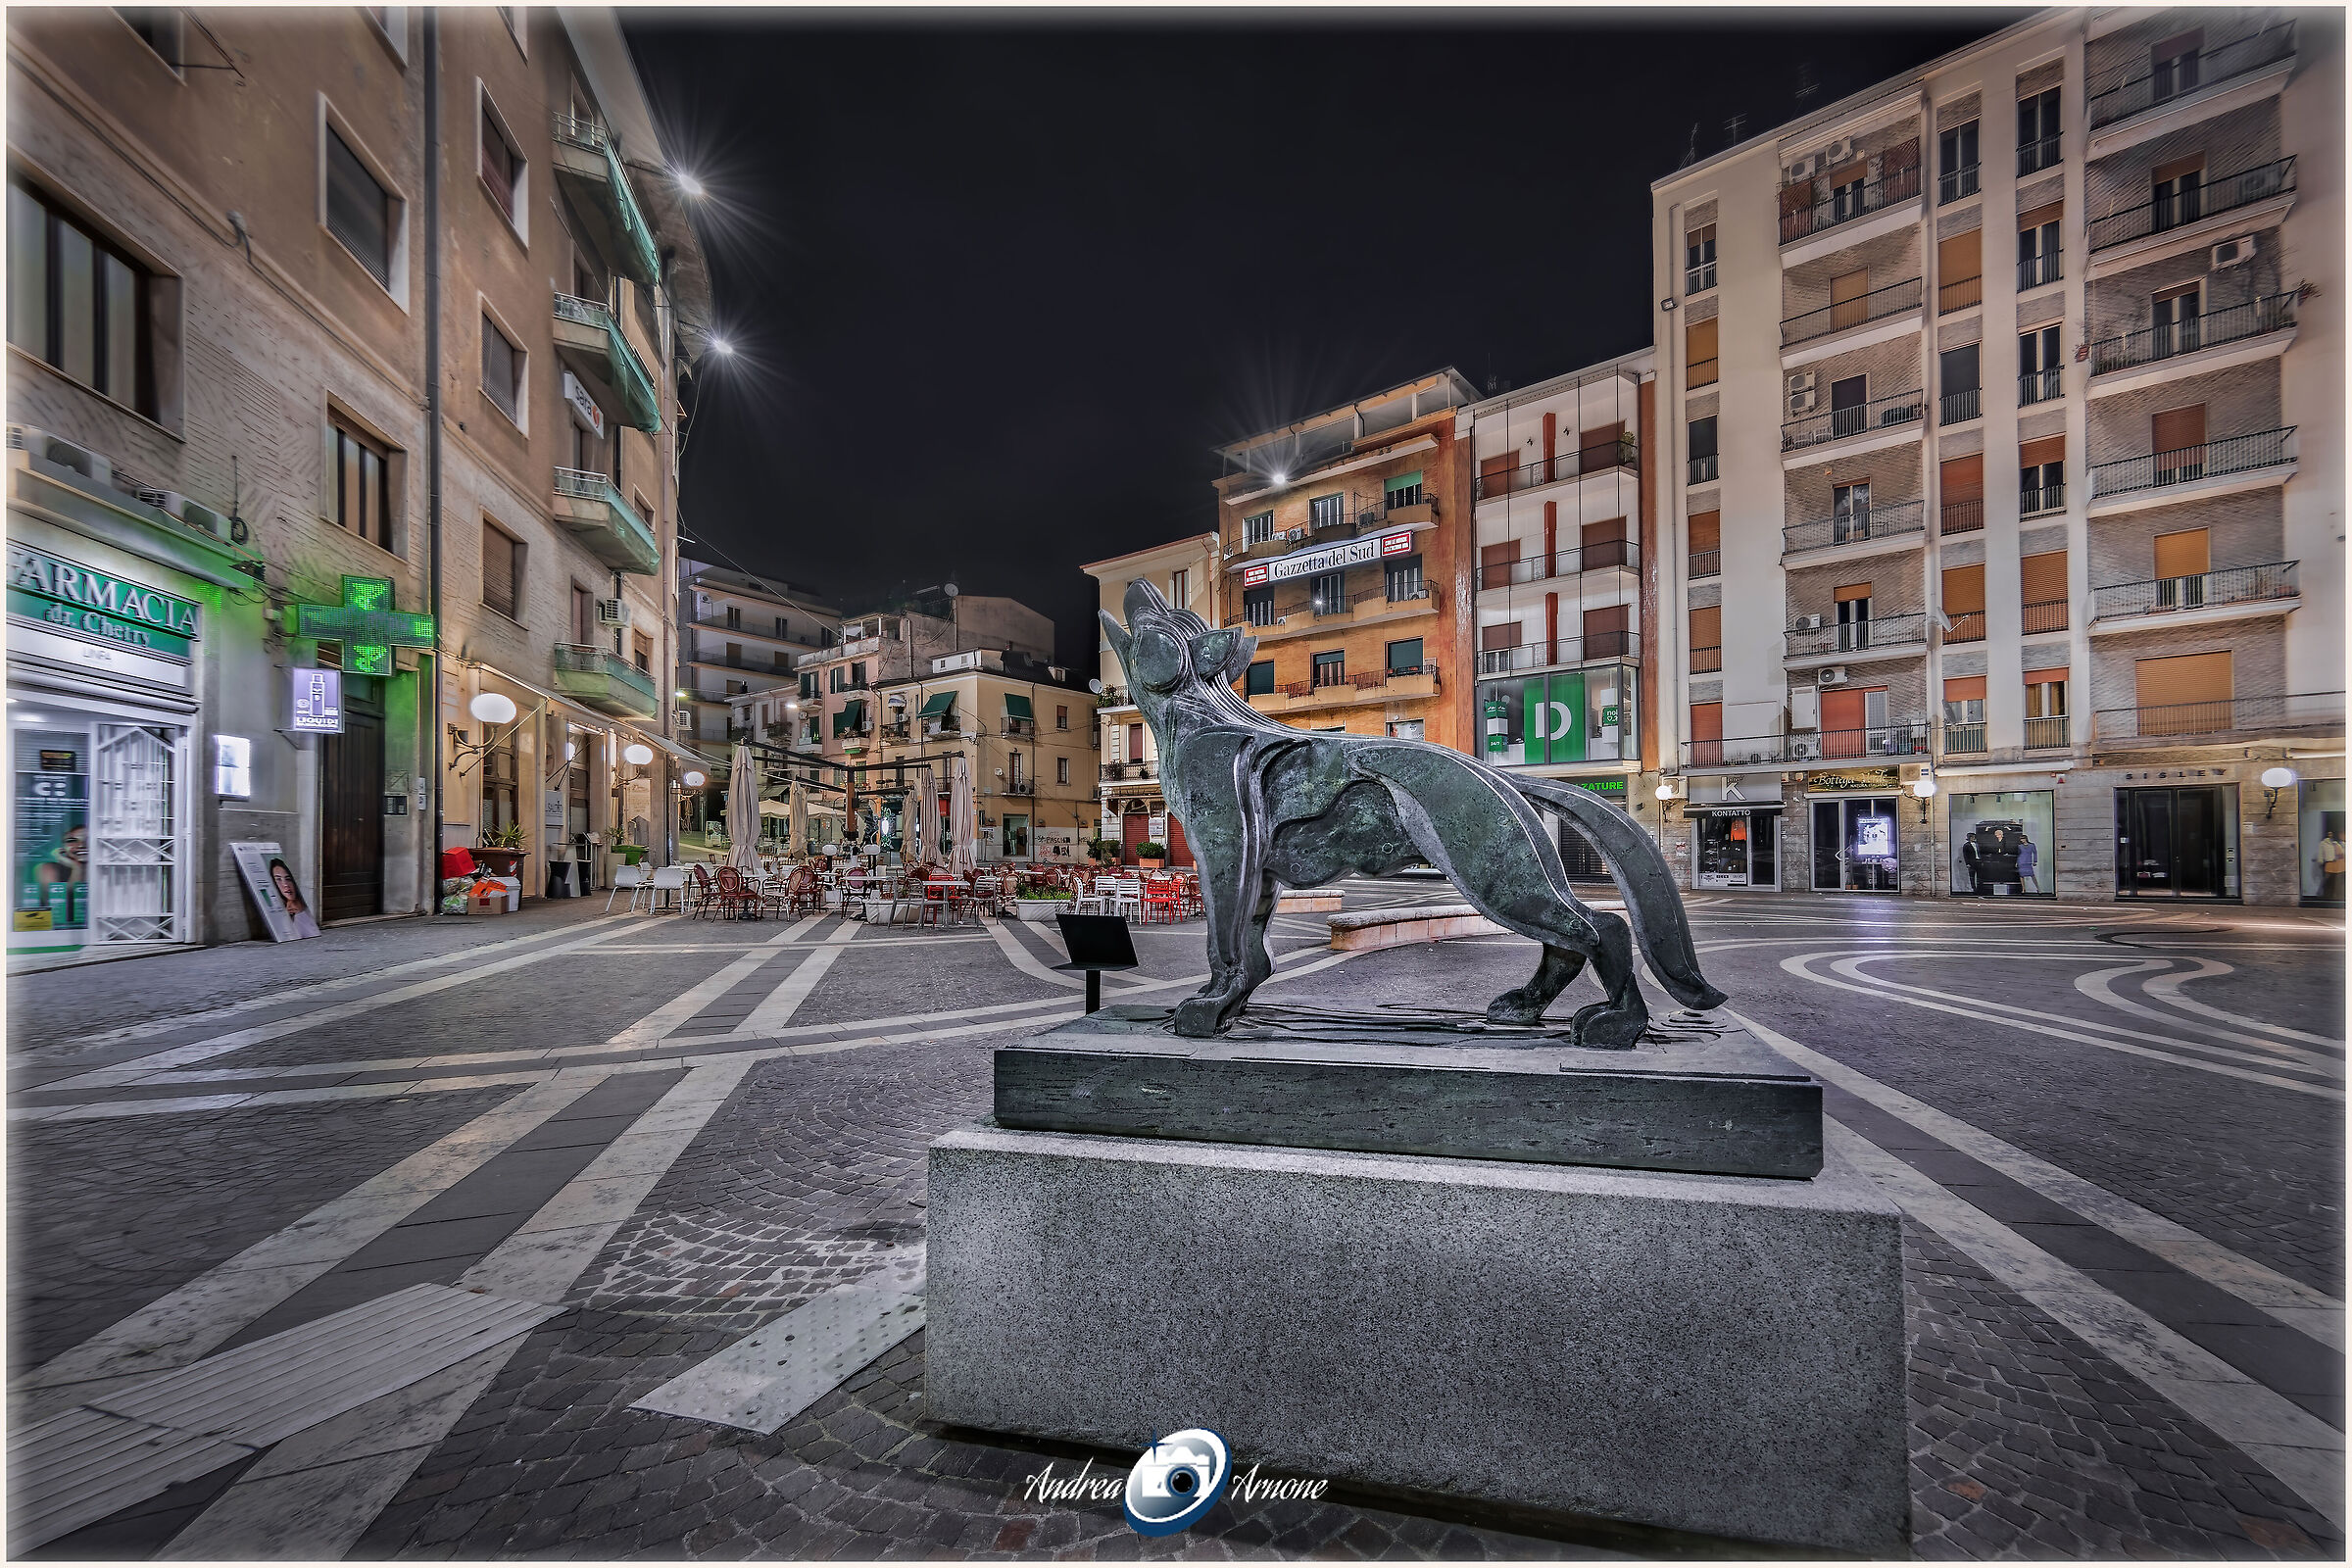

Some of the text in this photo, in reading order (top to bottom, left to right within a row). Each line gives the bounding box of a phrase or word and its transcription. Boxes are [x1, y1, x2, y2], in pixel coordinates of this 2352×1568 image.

[575, 385, 592, 416] sara
[1274, 558, 1324, 578] Gazzetta
[1328, 548, 1346, 567] del
[1349, 542, 1374, 562] Sud
[1535, 701, 1572, 741] D
[1575, 781, 1624, 791] ZATURE
[1814, 771, 1855, 788] Bottega
[2126, 768, 2227, 779] SISLEY
[1721, 776, 1746, 801] K
